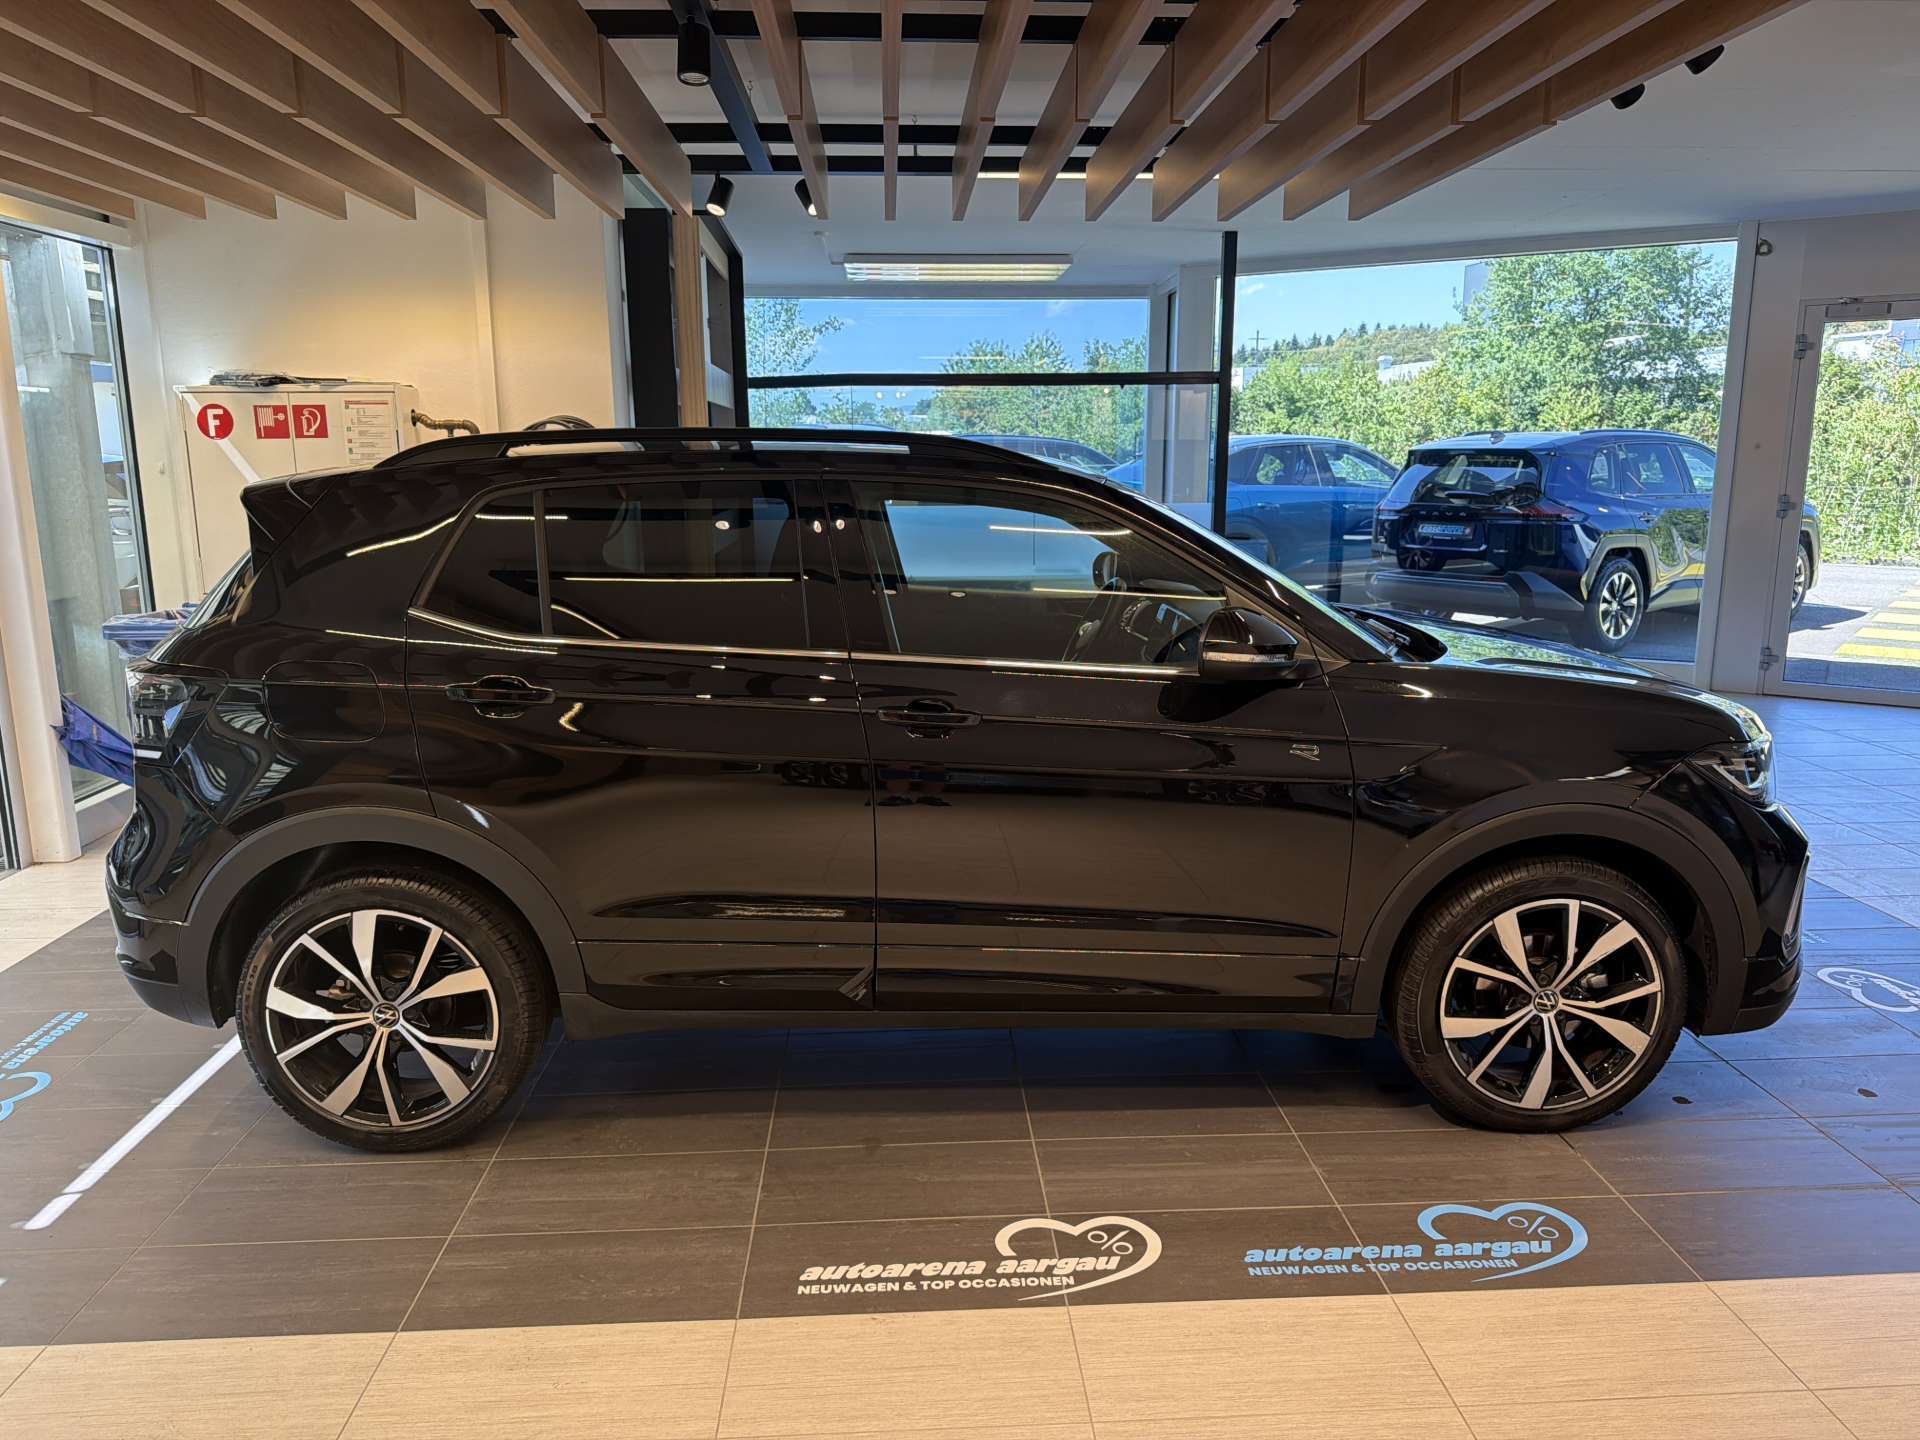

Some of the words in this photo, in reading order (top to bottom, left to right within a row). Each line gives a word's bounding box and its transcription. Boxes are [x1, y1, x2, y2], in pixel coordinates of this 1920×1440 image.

[206, 408, 224, 437] F
[1244, 1243, 1422, 1263] autoarena
[1434, 1240, 1552, 1258] aargau
[799, 1260, 987, 1281] autoarena
[996, 1255, 1121, 1275] aargau
[1248, 1264, 1349, 1277] NEUWAGEN
[1351, 1263, 1366, 1273] &
[1367, 1262, 1401, 1273] TOP
[1404, 1258, 1520, 1272] OCCASIONEN
[797, 1281, 900, 1296] NEUWAGEN
[903, 1280, 917, 1291] &
[920, 1279, 956, 1291] TOP
[958, 1275, 1076, 1289] OCCASIONEN
